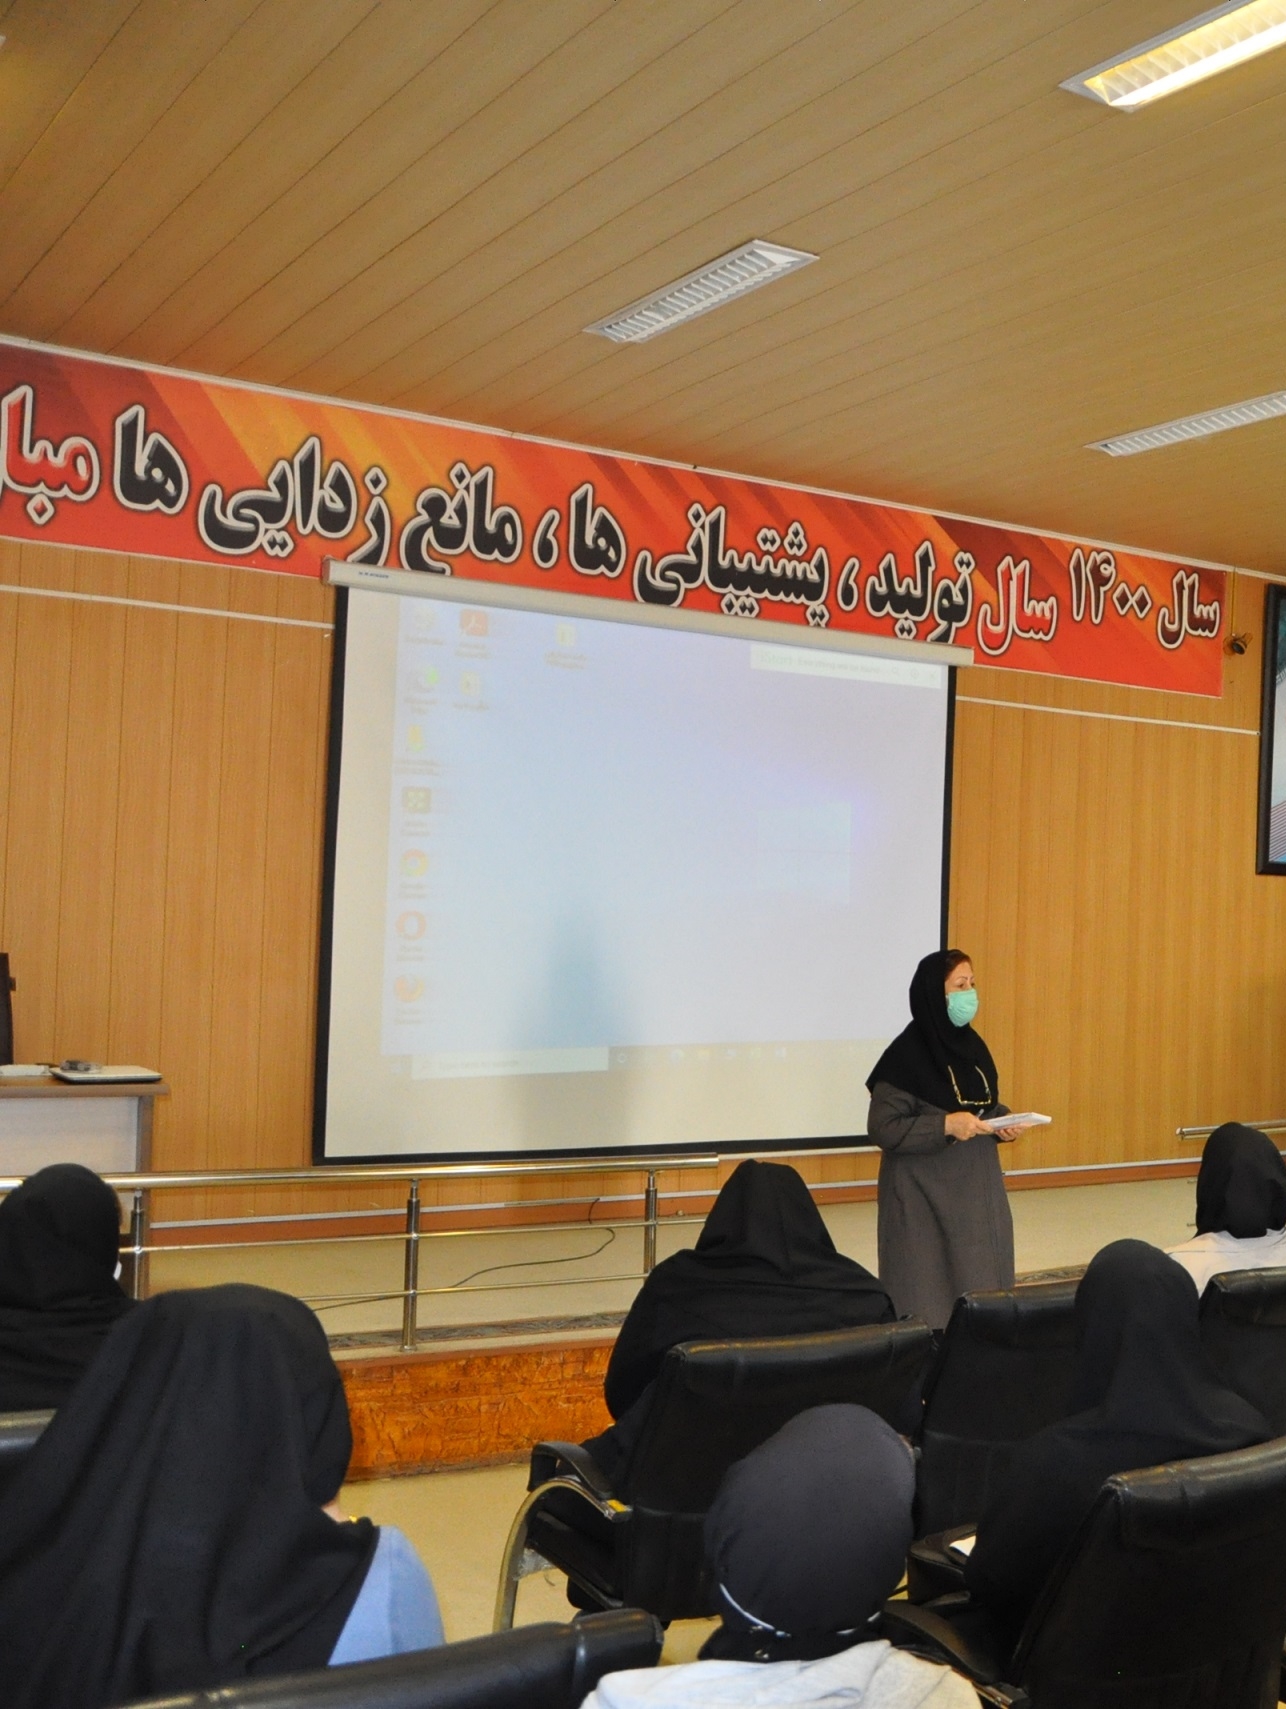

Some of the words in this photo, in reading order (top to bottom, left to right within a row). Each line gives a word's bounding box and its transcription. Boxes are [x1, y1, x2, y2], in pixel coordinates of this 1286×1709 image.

[113, 404, 189, 514] ها
[198, 436, 391, 567] زدایی
[400, 461, 523, 575] مانع
[633, 502, 829, 628] پشتیبانی
[977, 555, 1057, 655] سال
[1068, 548, 1151, 624] ۱۴۰۰
[1157, 570, 1219, 649] سال
